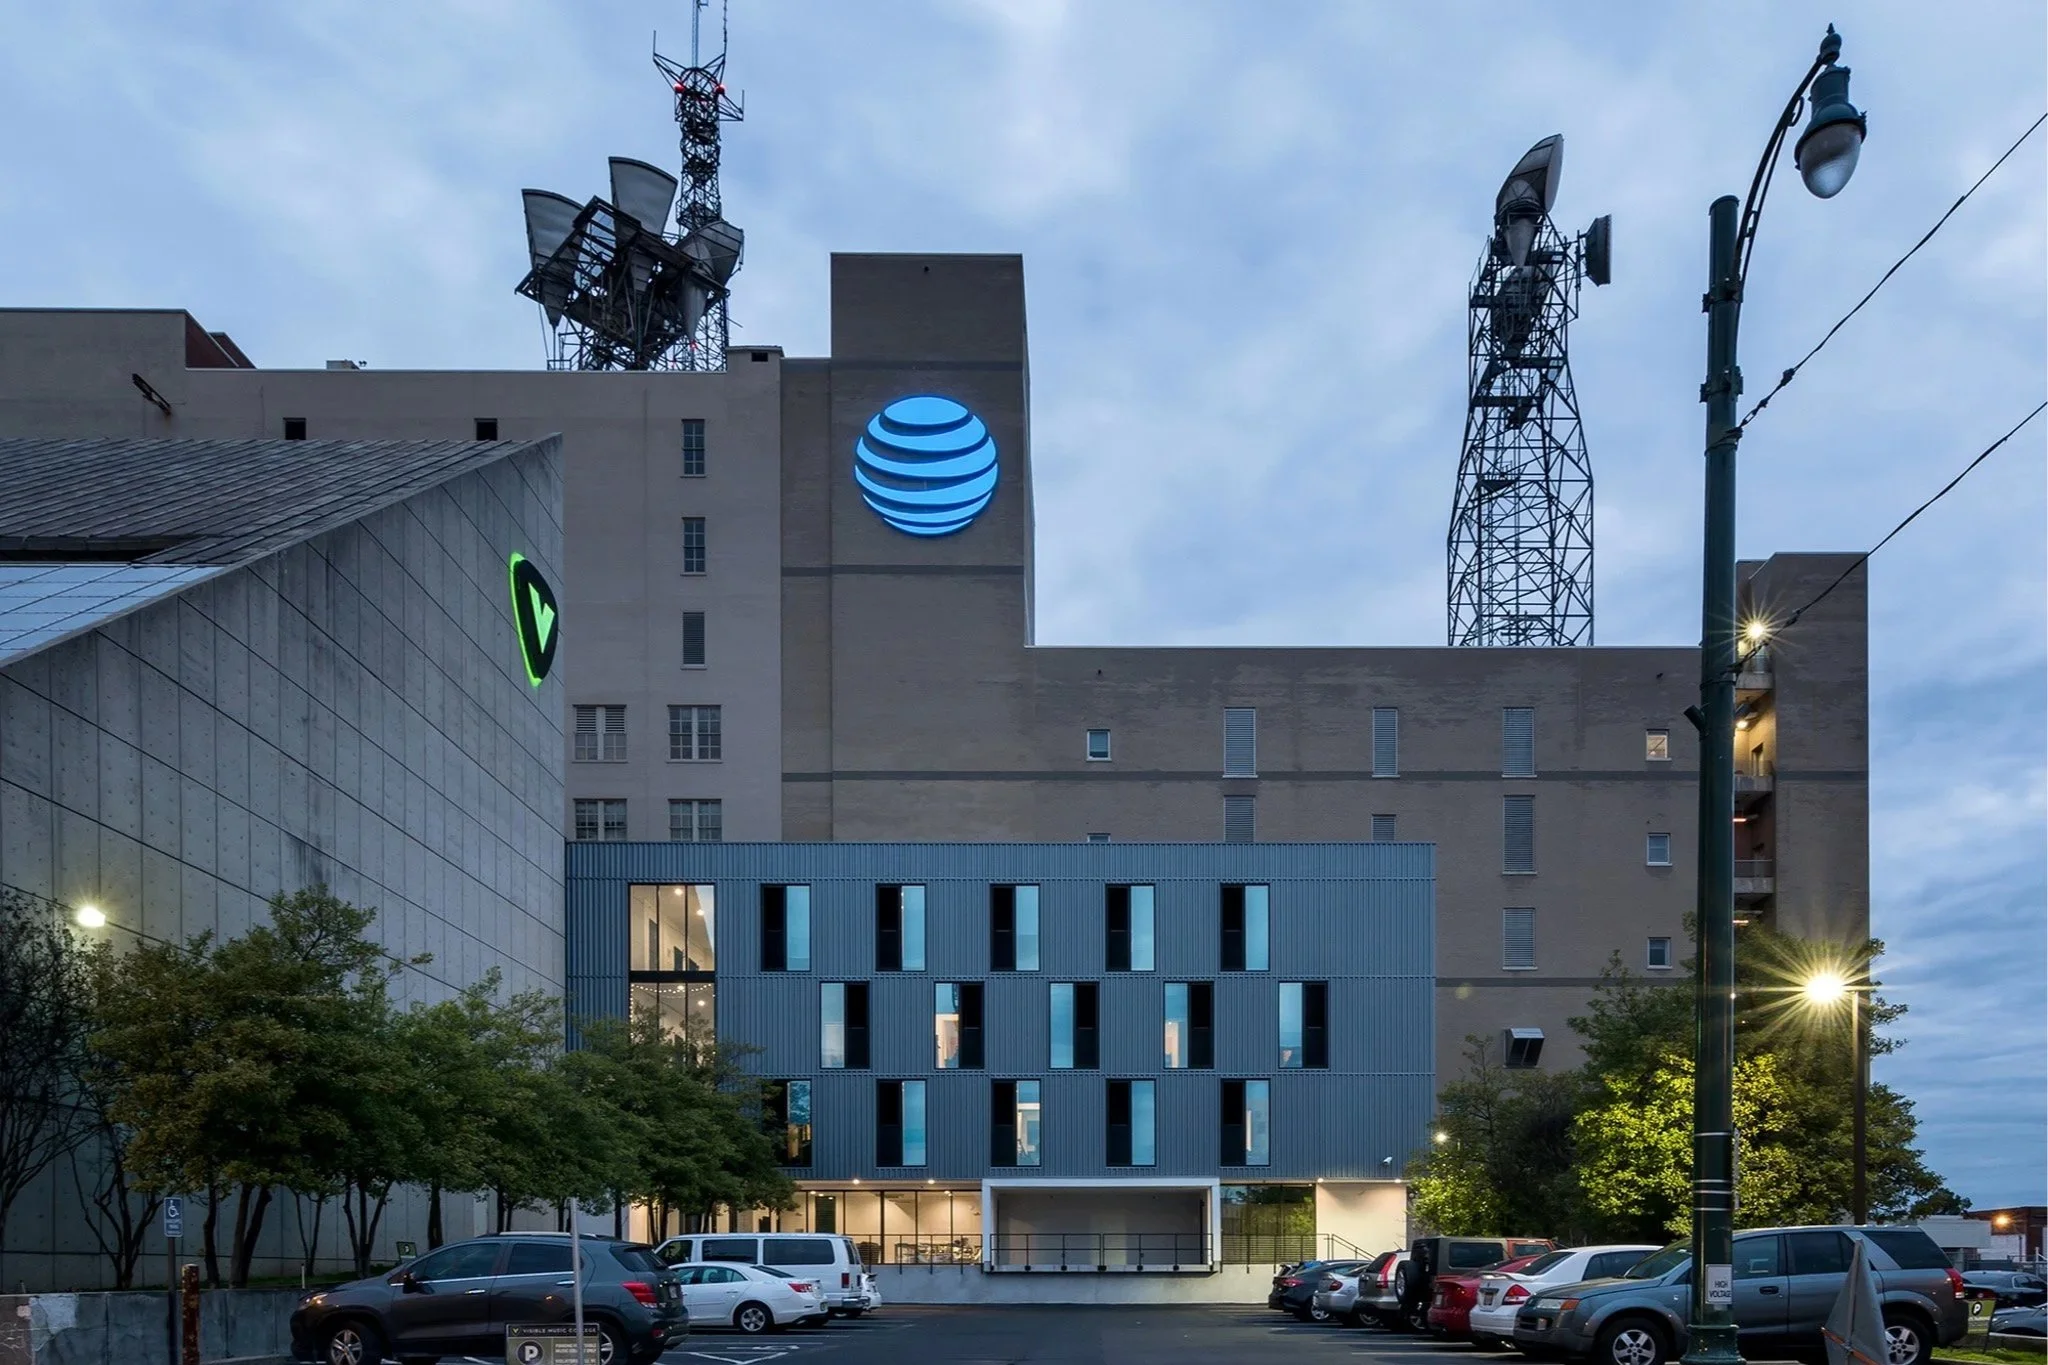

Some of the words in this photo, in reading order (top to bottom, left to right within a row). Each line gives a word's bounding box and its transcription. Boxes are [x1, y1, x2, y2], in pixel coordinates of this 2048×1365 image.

[1714, 1280, 1728, 1288] HIGH
[1709, 1290, 1731, 1298] VOLTAGE
[524, 1345, 539, 1362] P
